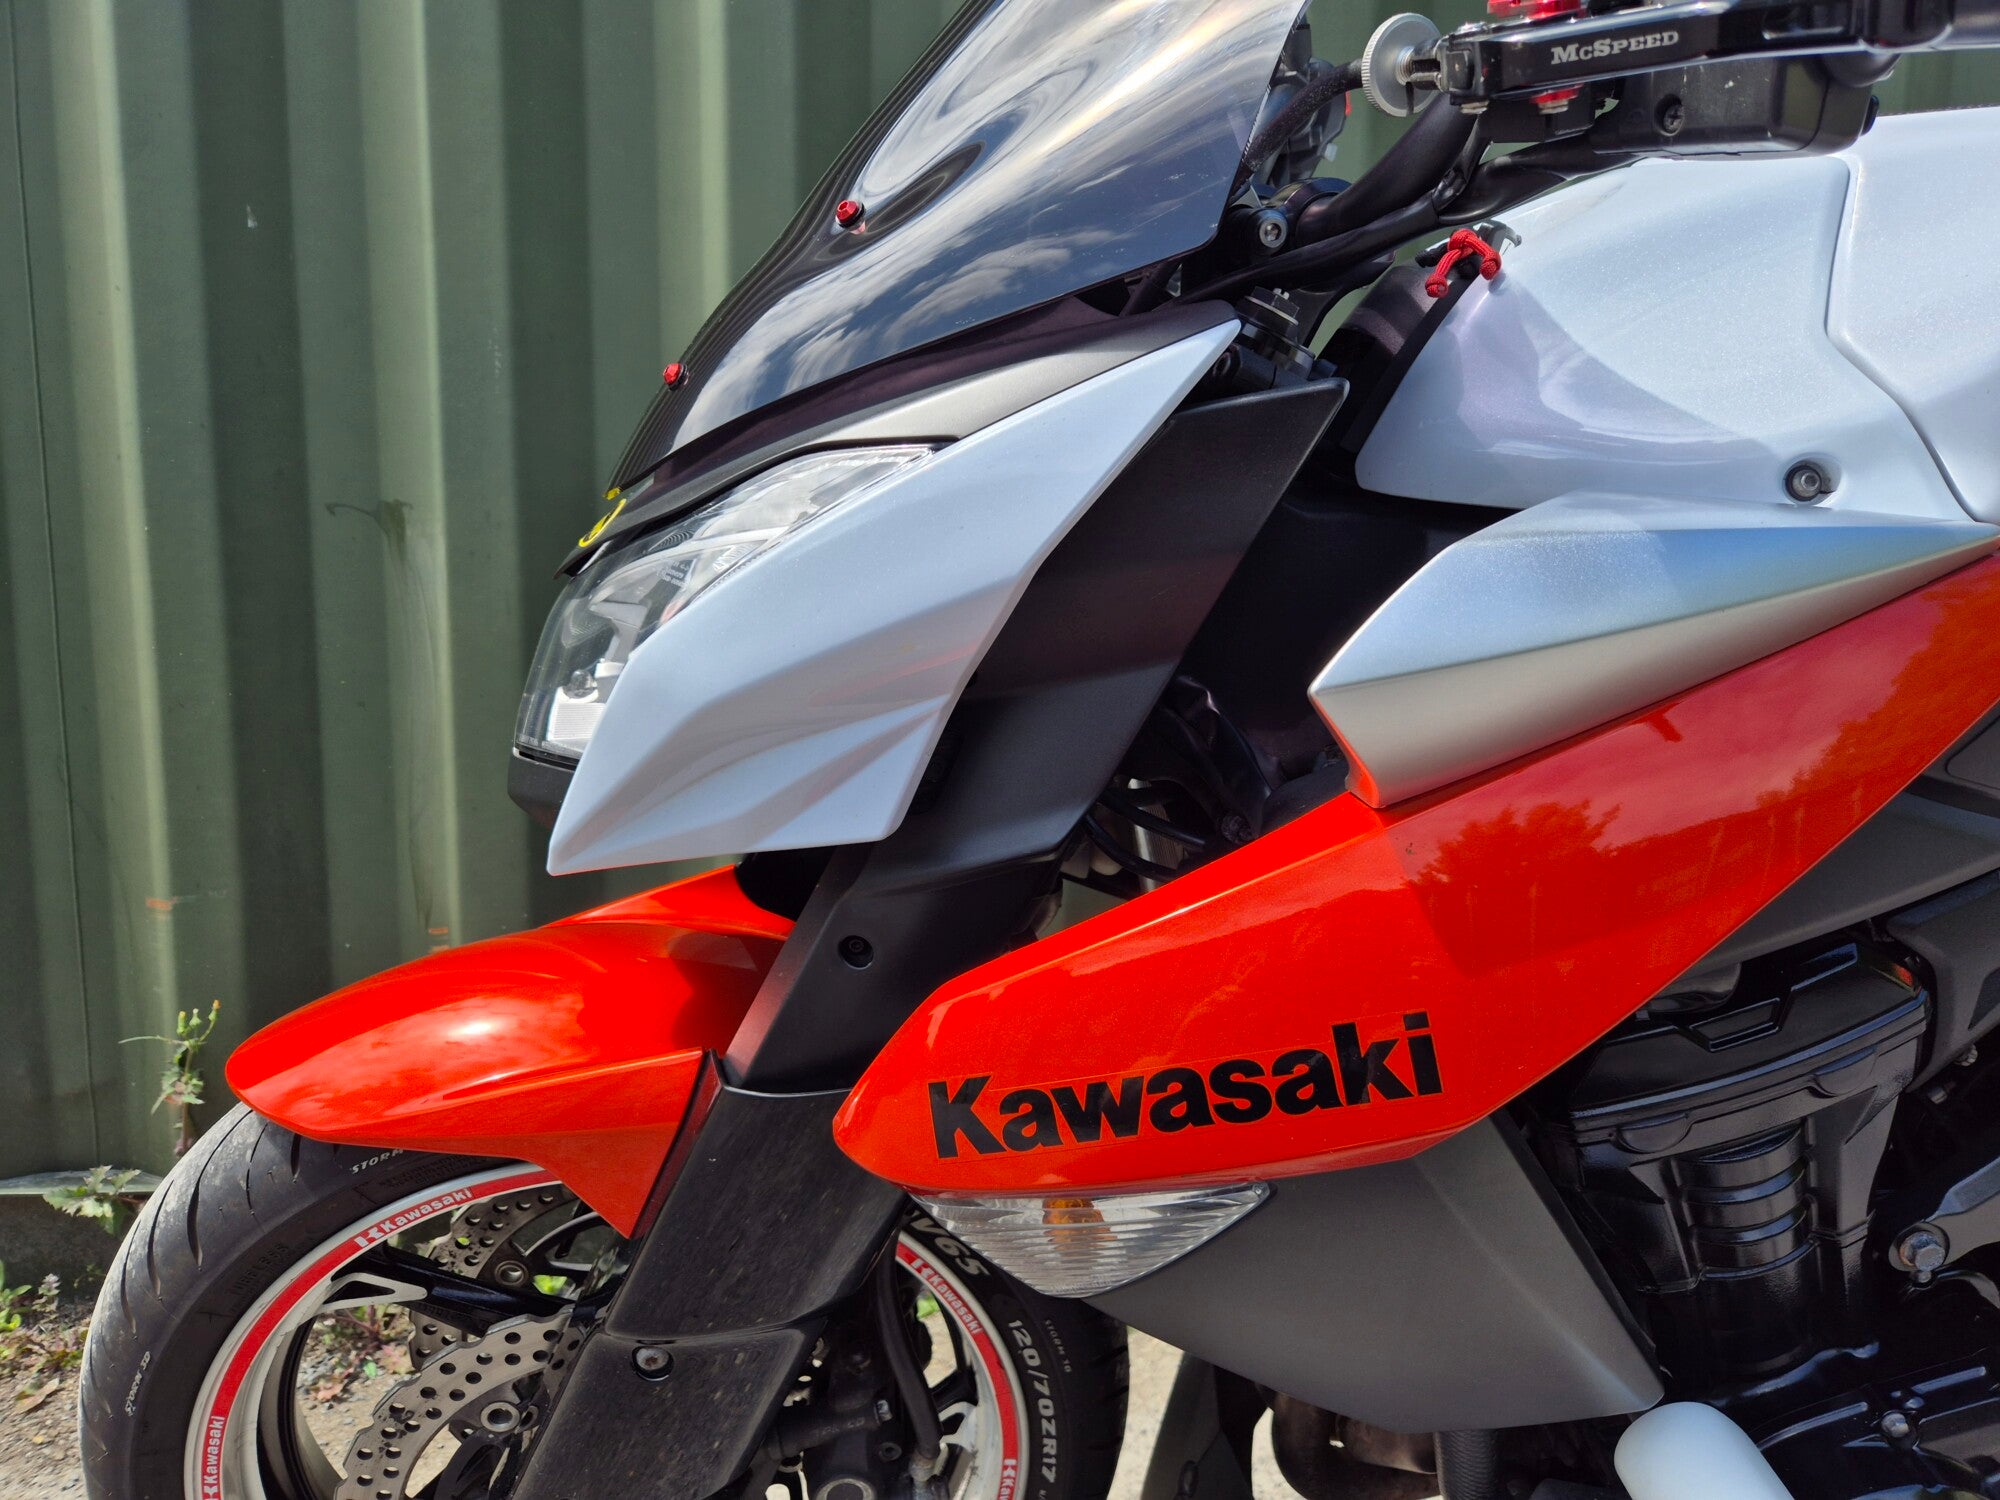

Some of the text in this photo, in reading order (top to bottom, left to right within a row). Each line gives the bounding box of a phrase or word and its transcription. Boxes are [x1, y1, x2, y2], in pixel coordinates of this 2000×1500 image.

[928, 1010, 1444, 1160] Kawasaki
[351, 1148, 403, 1175] STORM
[382, 1187, 473, 1232] Kawasaki
[928, 1274, 983, 1335] Kawasaki
[1007, 1319, 1058, 1484] 120/70ZR17
[203, 1415, 226, 1484] Kawasaki
